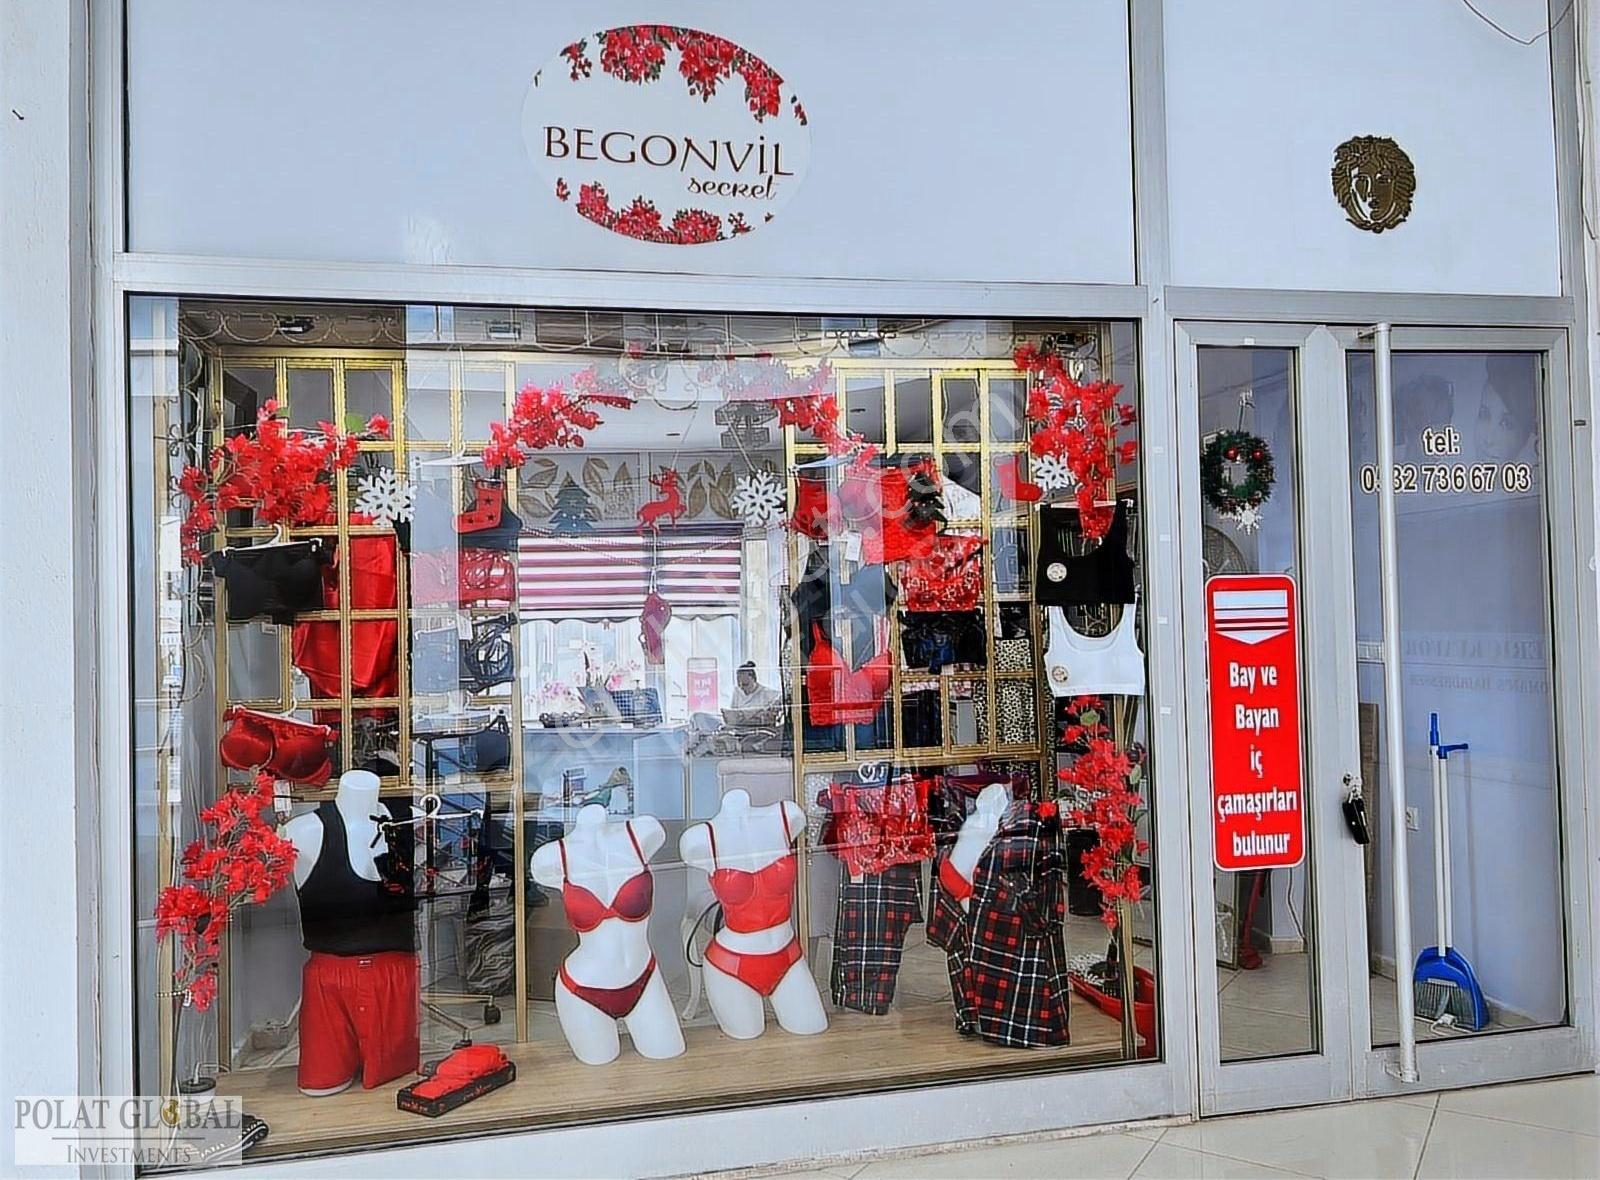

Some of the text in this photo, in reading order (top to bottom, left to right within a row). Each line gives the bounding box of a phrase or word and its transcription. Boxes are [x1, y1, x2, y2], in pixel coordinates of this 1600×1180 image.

[688, 175, 776, 201] secret
[1422, 426, 1461, 455] tel:
[1422, 465, 1466, 493] 736
[1470, 465, 1498, 492] 67
[1503, 465, 1531, 492] 03
[1229, 662, 1277, 693] Bay ve
[1235, 703, 1280, 735] Bayan
[1250, 744, 1264, 778] iç
[1217, 785, 1298, 822] çamaşırları
[1232, 832, 1291, 857] bulunur
